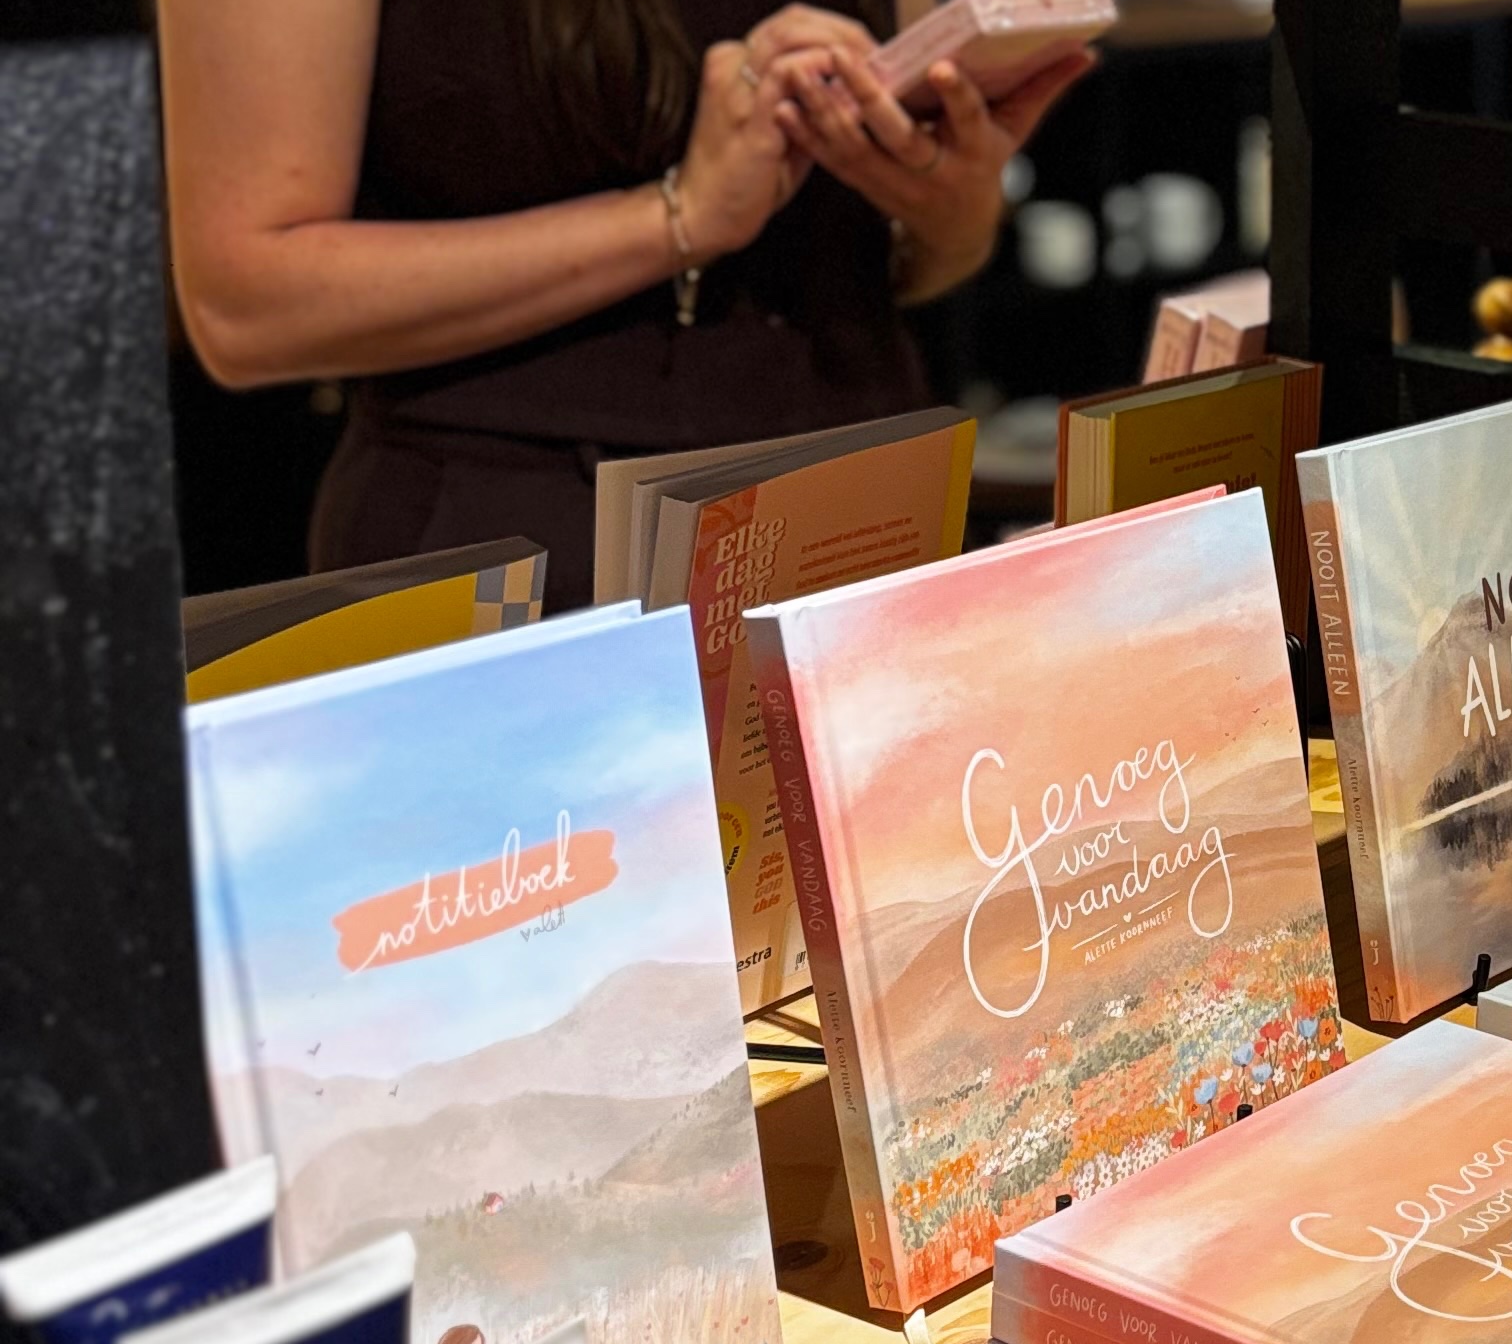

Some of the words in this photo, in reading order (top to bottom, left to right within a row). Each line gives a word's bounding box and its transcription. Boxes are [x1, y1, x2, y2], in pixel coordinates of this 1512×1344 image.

[714, 516, 787, 566] Elke
[715, 542, 778, 594] dag
[1311, 530, 1340, 603] NOOIT
[704, 578, 772, 629] met
[706, 619, 748, 654] Go
[1321, 612, 1351, 696] ALLEEN
[745, 713, 760, 725] God
[1348, 758, 1359, 793] Alette
[766, 689, 794, 763] GENOEG
[784, 778, 807, 824] VOOR
[798, 839, 827, 932] VANDAAG
[1352, 796, 1369, 859] Koornneef
[755, 862, 785, 887] you
[1054, 821, 1130, 876] voor
[343, 809, 576, 979] notitieboek
[752, 893, 781, 915] this
[961, 739, 1196, 1019] Genoeg
[1022, 826, 1237, 938] vandaag
[736, 946, 772, 973] estra
[1084, 937, 1117, 966] ALETTE
[1120, 907, 1174, 945] KOORNNEEF
[827, 991, 840, 1032] Alette
[835, 1036, 857, 1114] Koornneef
[1049, 1283, 1108, 1323] GENOEG
[1119, 1309, 1158, 1343] VOOR
